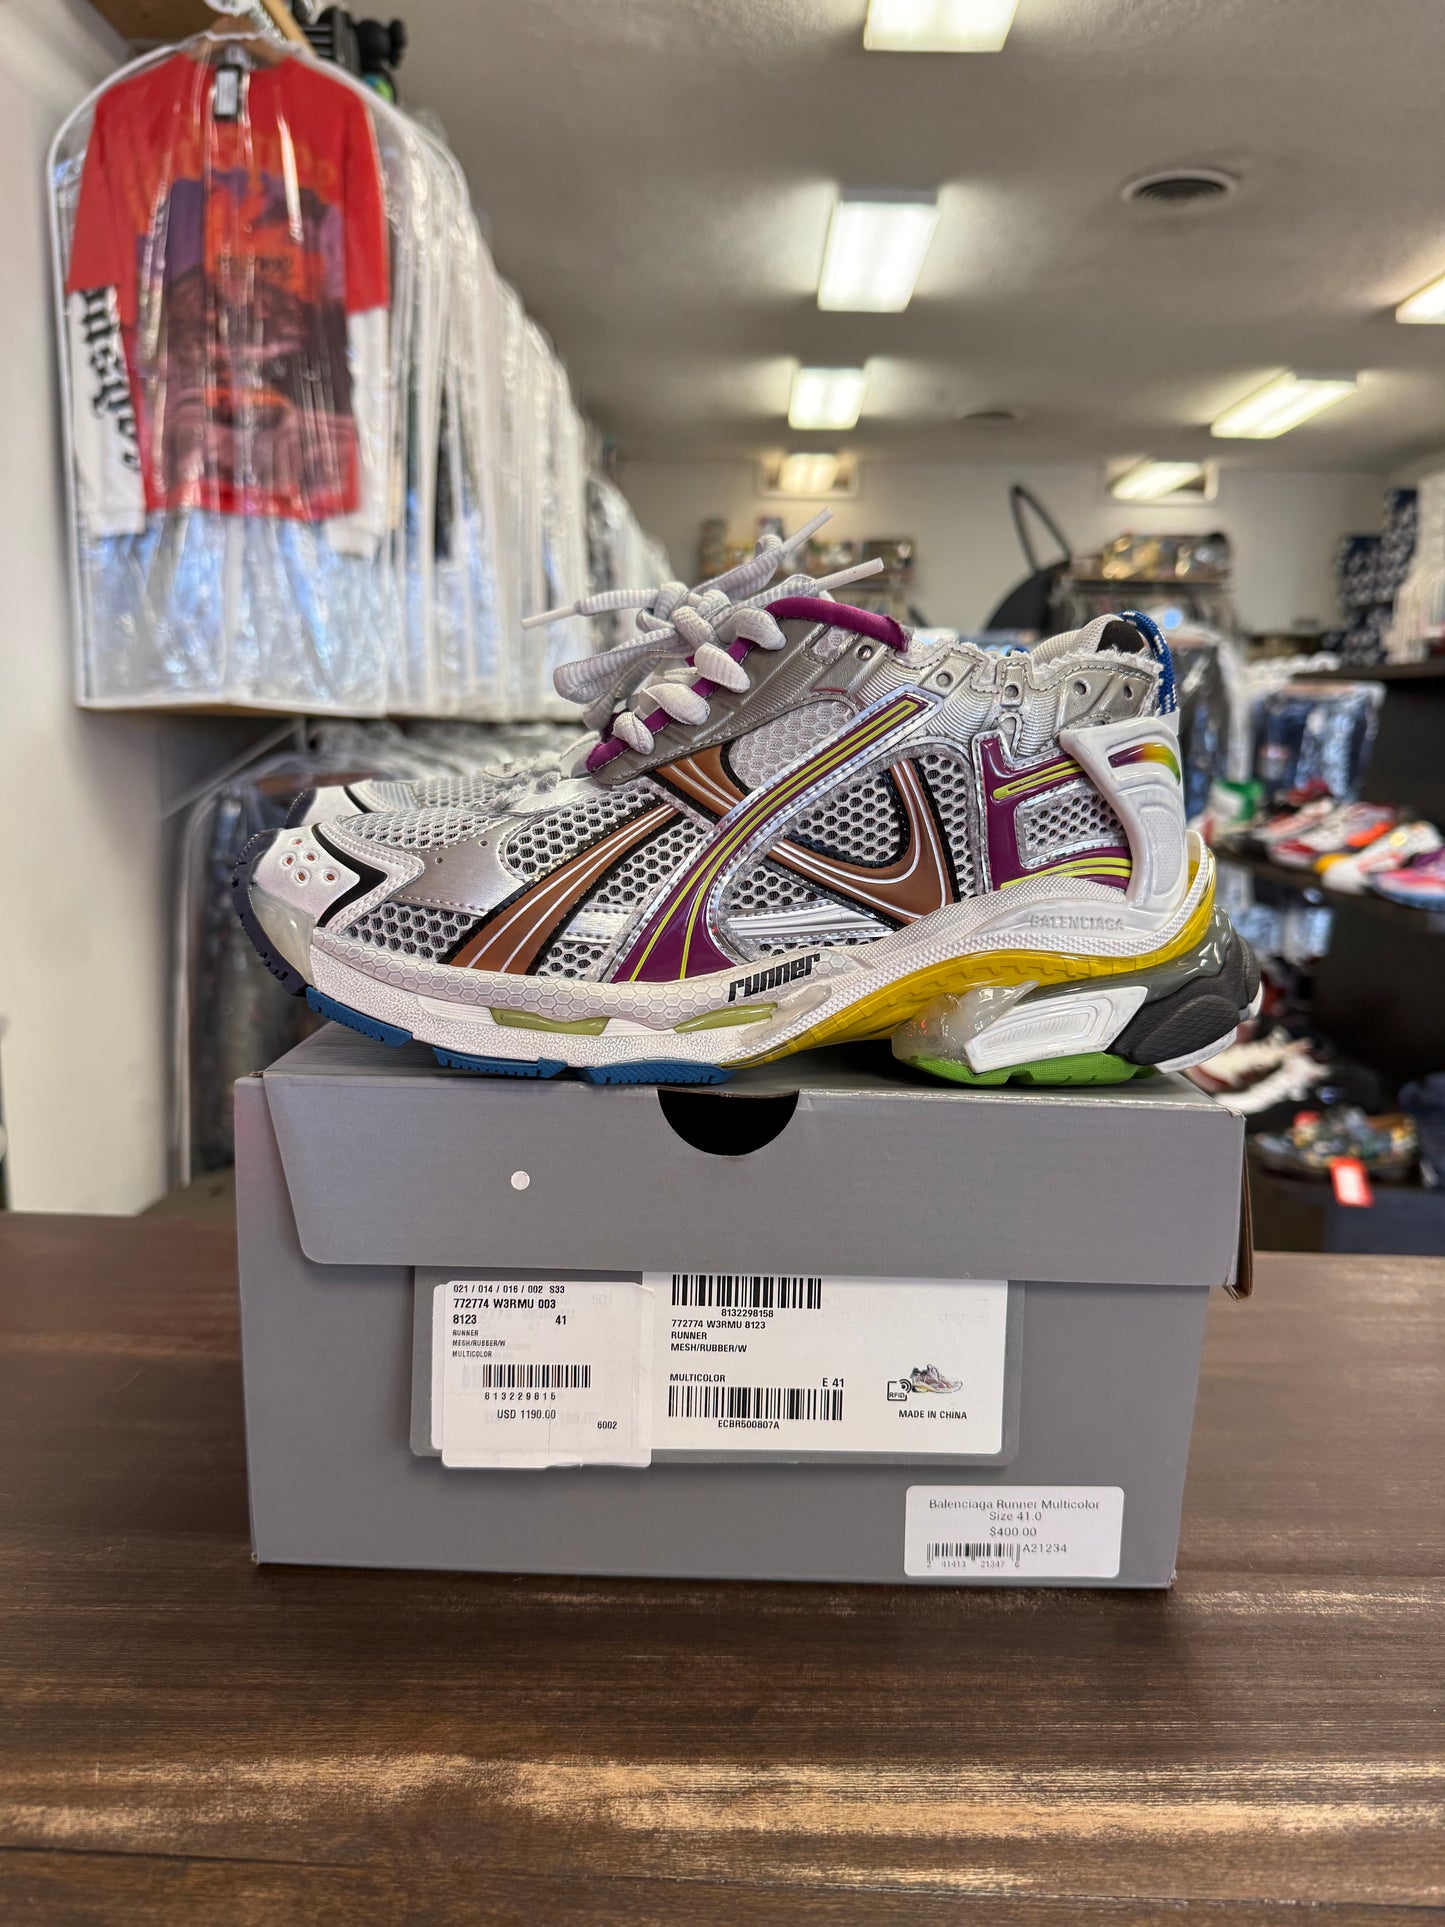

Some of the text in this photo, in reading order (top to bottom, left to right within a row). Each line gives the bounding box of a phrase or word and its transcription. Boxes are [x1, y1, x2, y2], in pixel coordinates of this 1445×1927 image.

[1030, 915, 1124, 931] BALENCIAGA
[728, 953, 820, 1002] runner
[453, 1285, 468, 1293] 021
[478, 1285, 493, 1293] 014
[503, 1285, 518, 1293] 016
[453, 1298, 556, 1308] 772774 W3RMU 003
[721, 1308, 774, 1317] 8132298158
[452, 1314, 477, 1324] 8123
[555, 1315, 567, 1325] 41
[671, 1319, 766, 1329] 772774 W3RMU 8123
[671, 1331, 707, 1340] RUNNER
[670, 1343, 747, 1352] MESH/RUBBER/W
[669, 1373, 726, 1382] MULTICOLOR
[822, 1377, 844, 1387] E 41
[497, 1409, 516, 1419] USD
[520, 1409, 556, 1419] 1190.00
[898, 1410, 967, 1419] MADE IN CHINA
[597, 1421, 618, 1429] 6002
[717, 1419, 780, 1429] ECBR500807A
[929, 1499, 1099, 1510] Balenciaga Runner Multicolor
[989, 1511, 1042, 1520] Size 41.0
[1022, 1543, 1067, 1552] A21234
